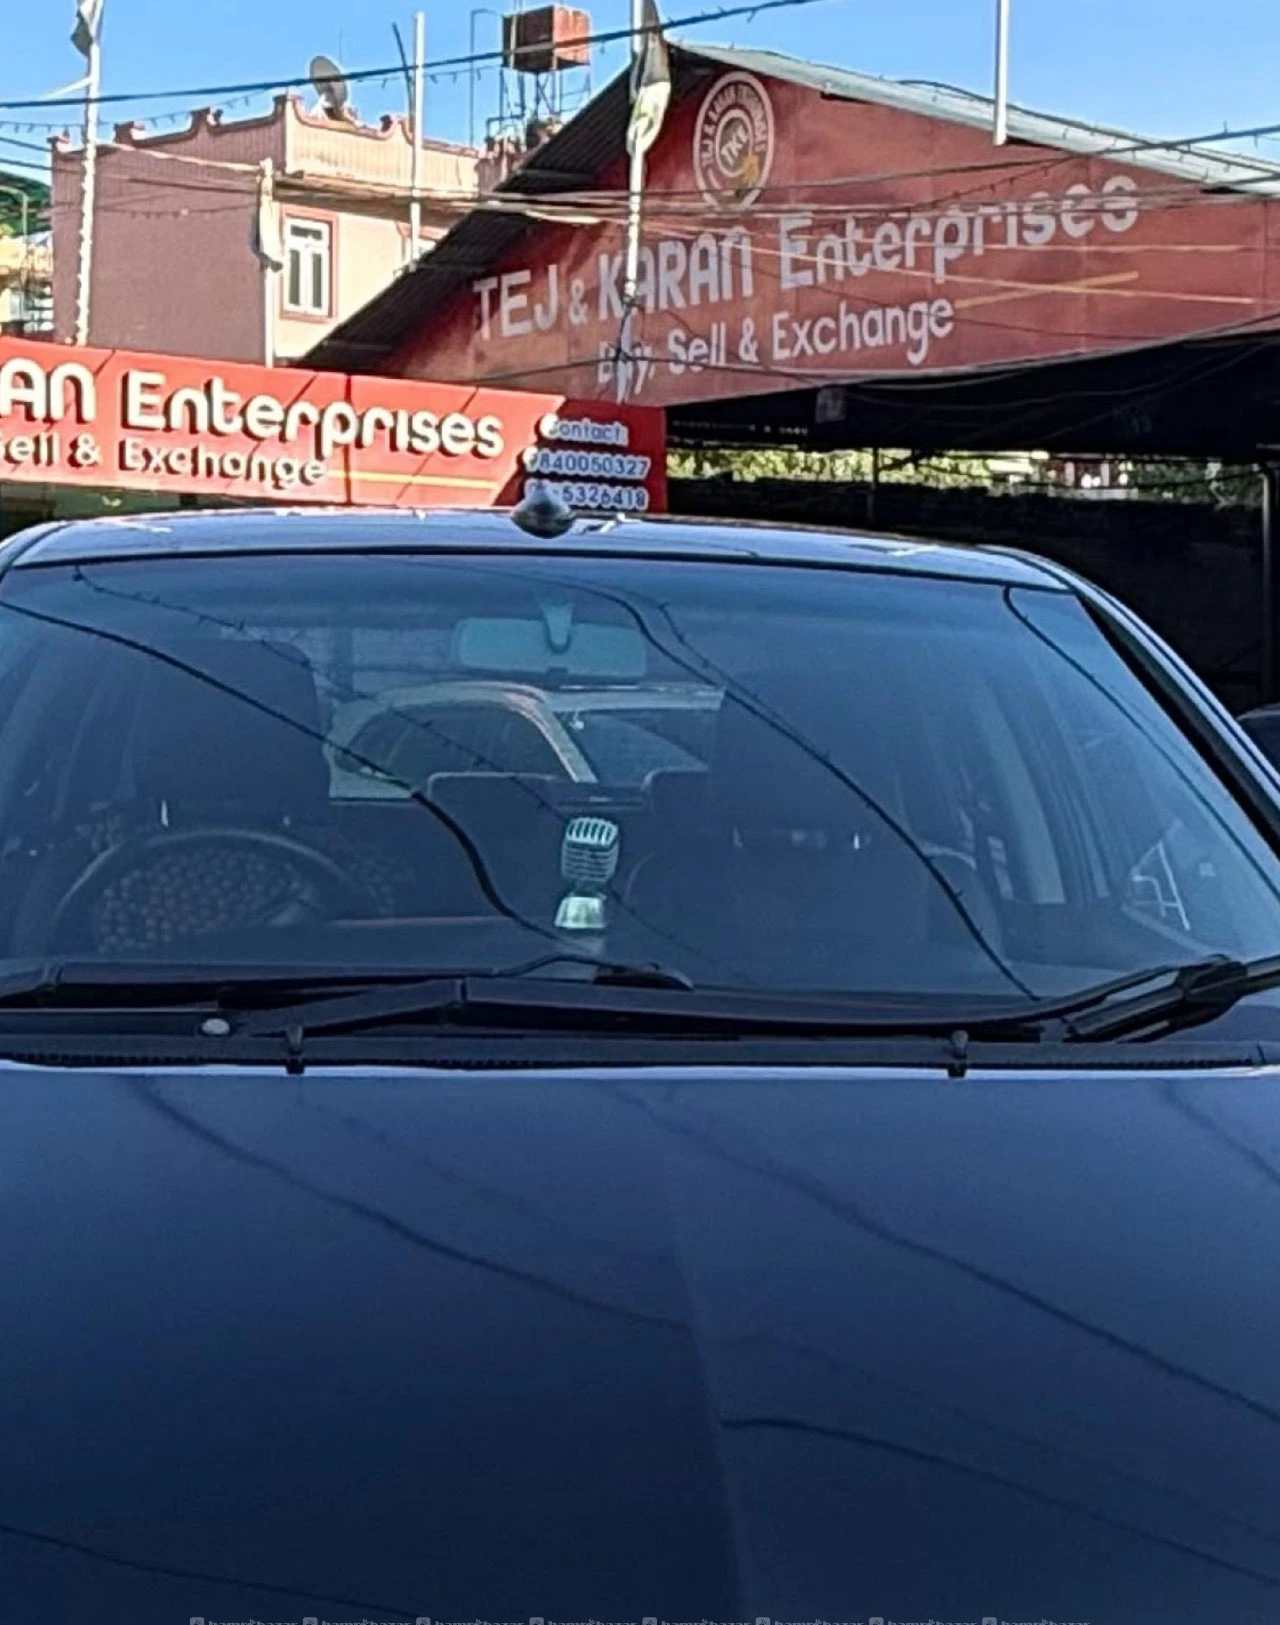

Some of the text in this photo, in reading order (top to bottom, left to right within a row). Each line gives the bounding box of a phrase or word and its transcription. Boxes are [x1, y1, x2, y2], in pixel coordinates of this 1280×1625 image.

[473, 175, 1138, 341] TEJ & KARAN Enterprises
[598, 299, 955, 395] By, Sell & Exchange
[122, 368, 505, 460] Enterprises
[72, 433, 103, 466] &
[120, 438, 327, 491] Exchange
